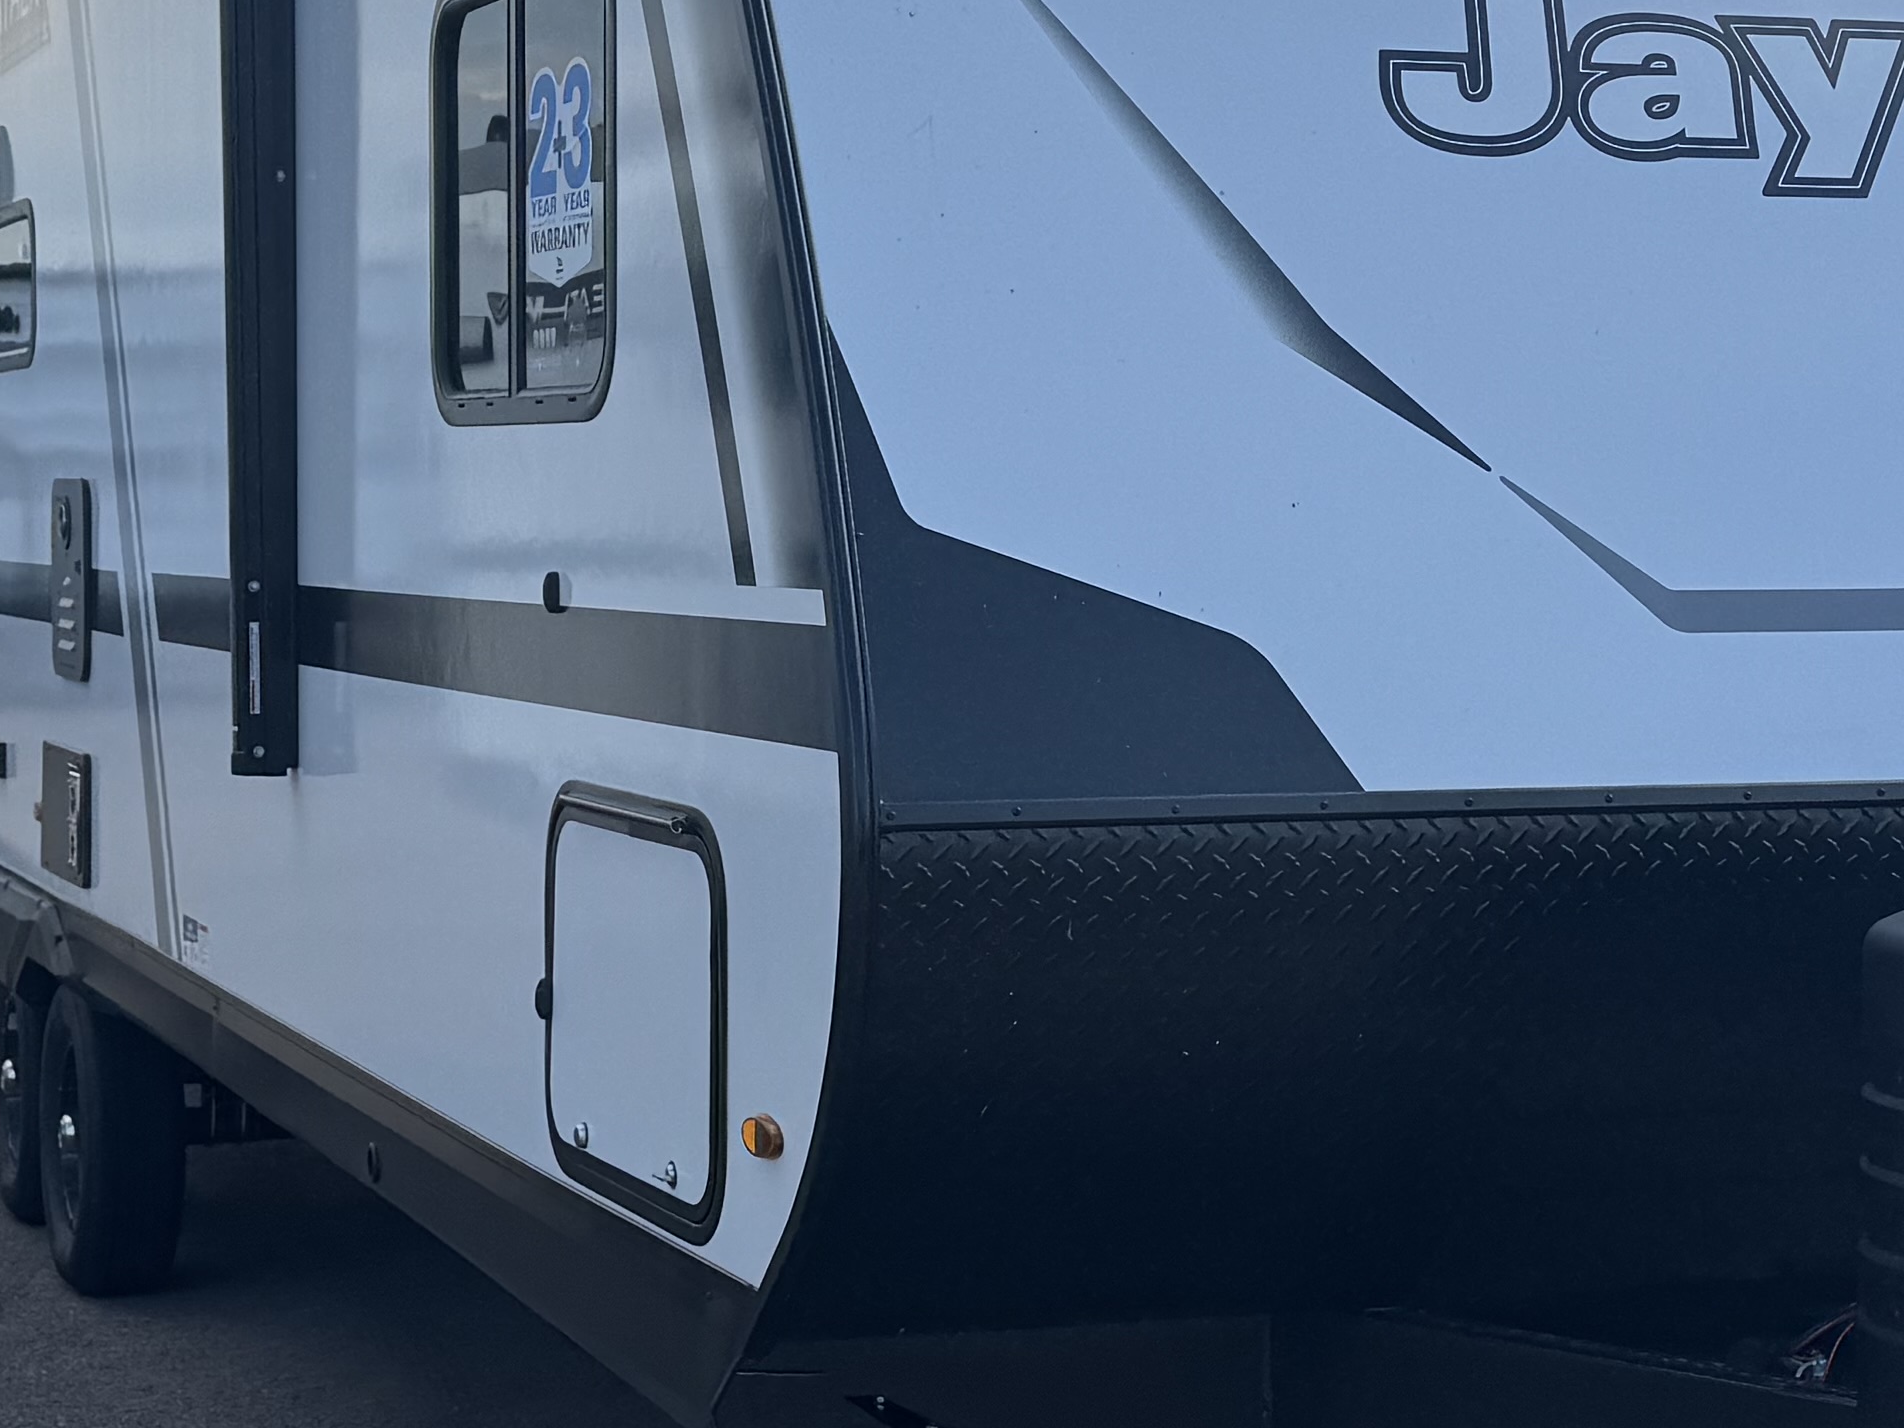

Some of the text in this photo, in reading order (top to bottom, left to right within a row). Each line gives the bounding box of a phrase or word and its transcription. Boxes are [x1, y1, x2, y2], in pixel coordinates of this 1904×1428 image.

[531, 189, 591, 219] YEAR YEAR
[530, 222, 591, 255] WARRANTY
